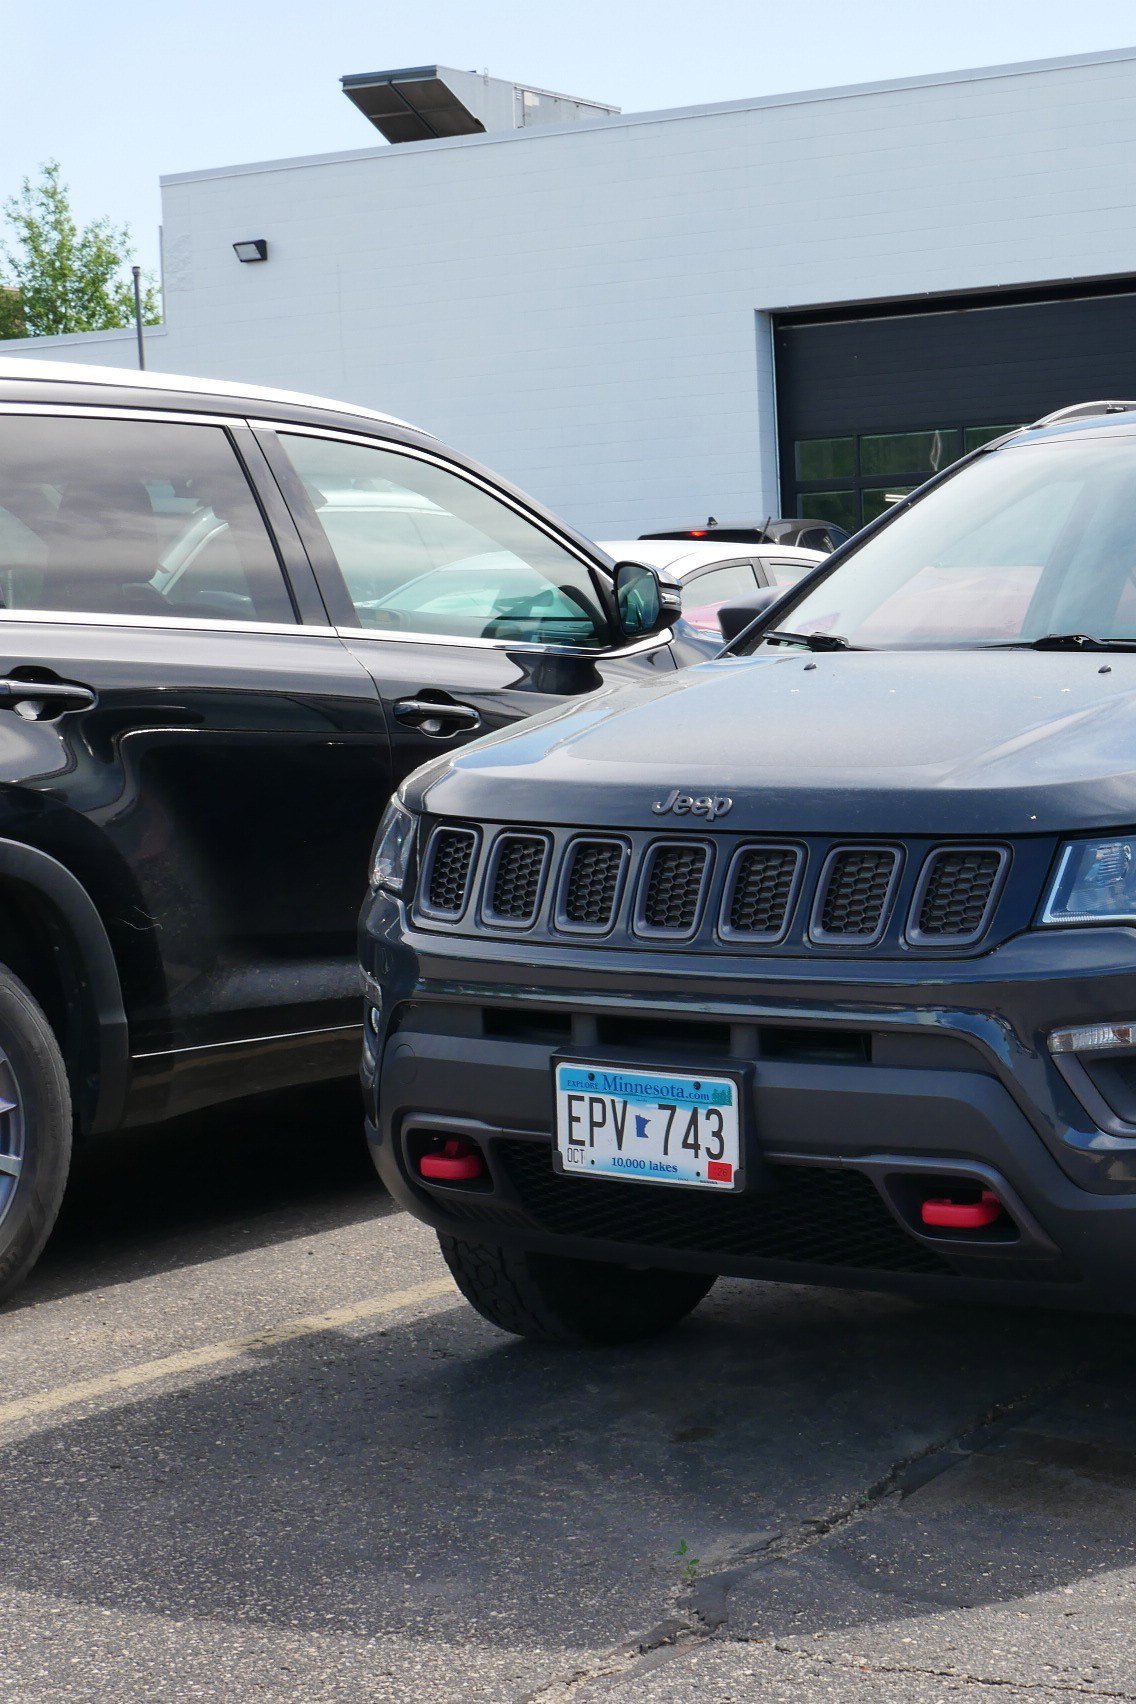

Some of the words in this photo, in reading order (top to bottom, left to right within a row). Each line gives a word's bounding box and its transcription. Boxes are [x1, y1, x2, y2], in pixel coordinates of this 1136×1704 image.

[651, 789, 733, 822] Jeep
[567, 1079, 600, 1090] EXPLORE
[567, 1094, 628, 1151] EPV
[658, 1103, 725, 1161] 743
[567, 1148, 586, 1165] OCT
[611, 1157, 646, 1170] 10,000
[650, 1160, 679, 1173] lakes
